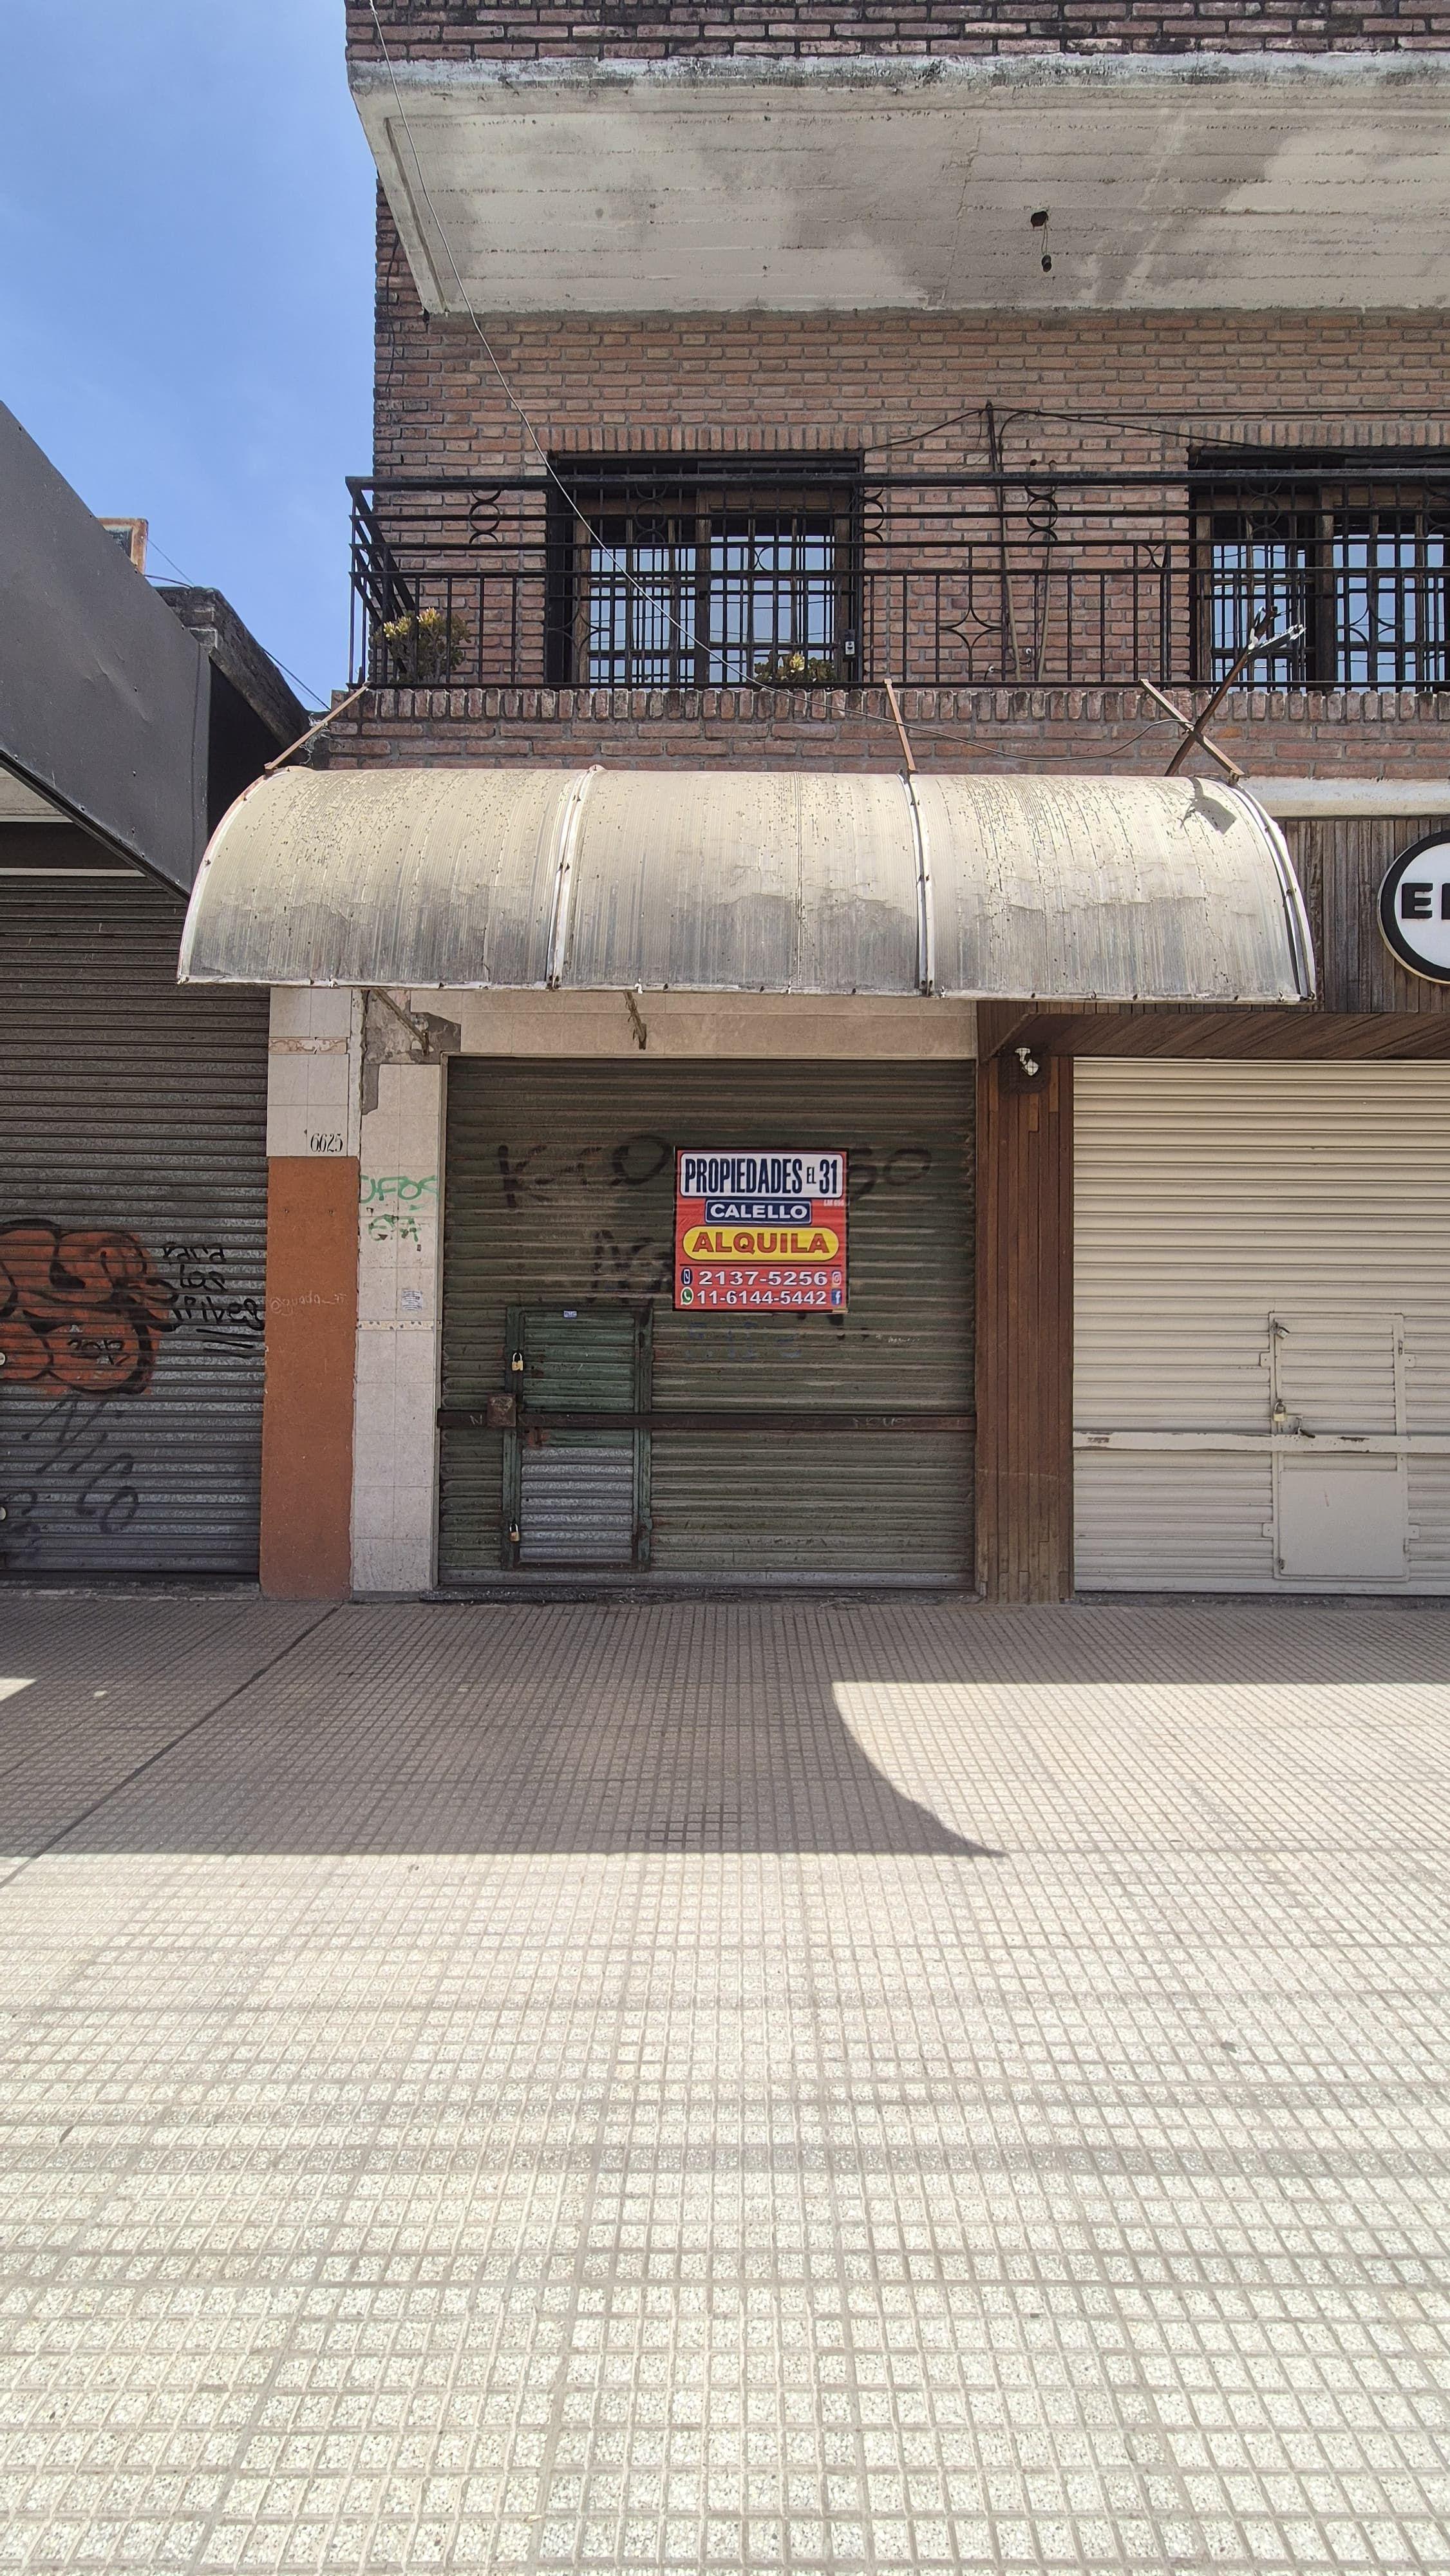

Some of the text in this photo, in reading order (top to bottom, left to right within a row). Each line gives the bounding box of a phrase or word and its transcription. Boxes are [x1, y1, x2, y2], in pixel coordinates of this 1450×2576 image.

[684, 1158, 838, 1195] PROPIEDADES EL 31
[710, 1204, 808, 1219] CALELLO
[692, 1231, 830, 1255] ALQUILA
[698, 1271, 828, 1286] 2137-5256
[697, 1290, 827, 1305] 11-6144-5442
